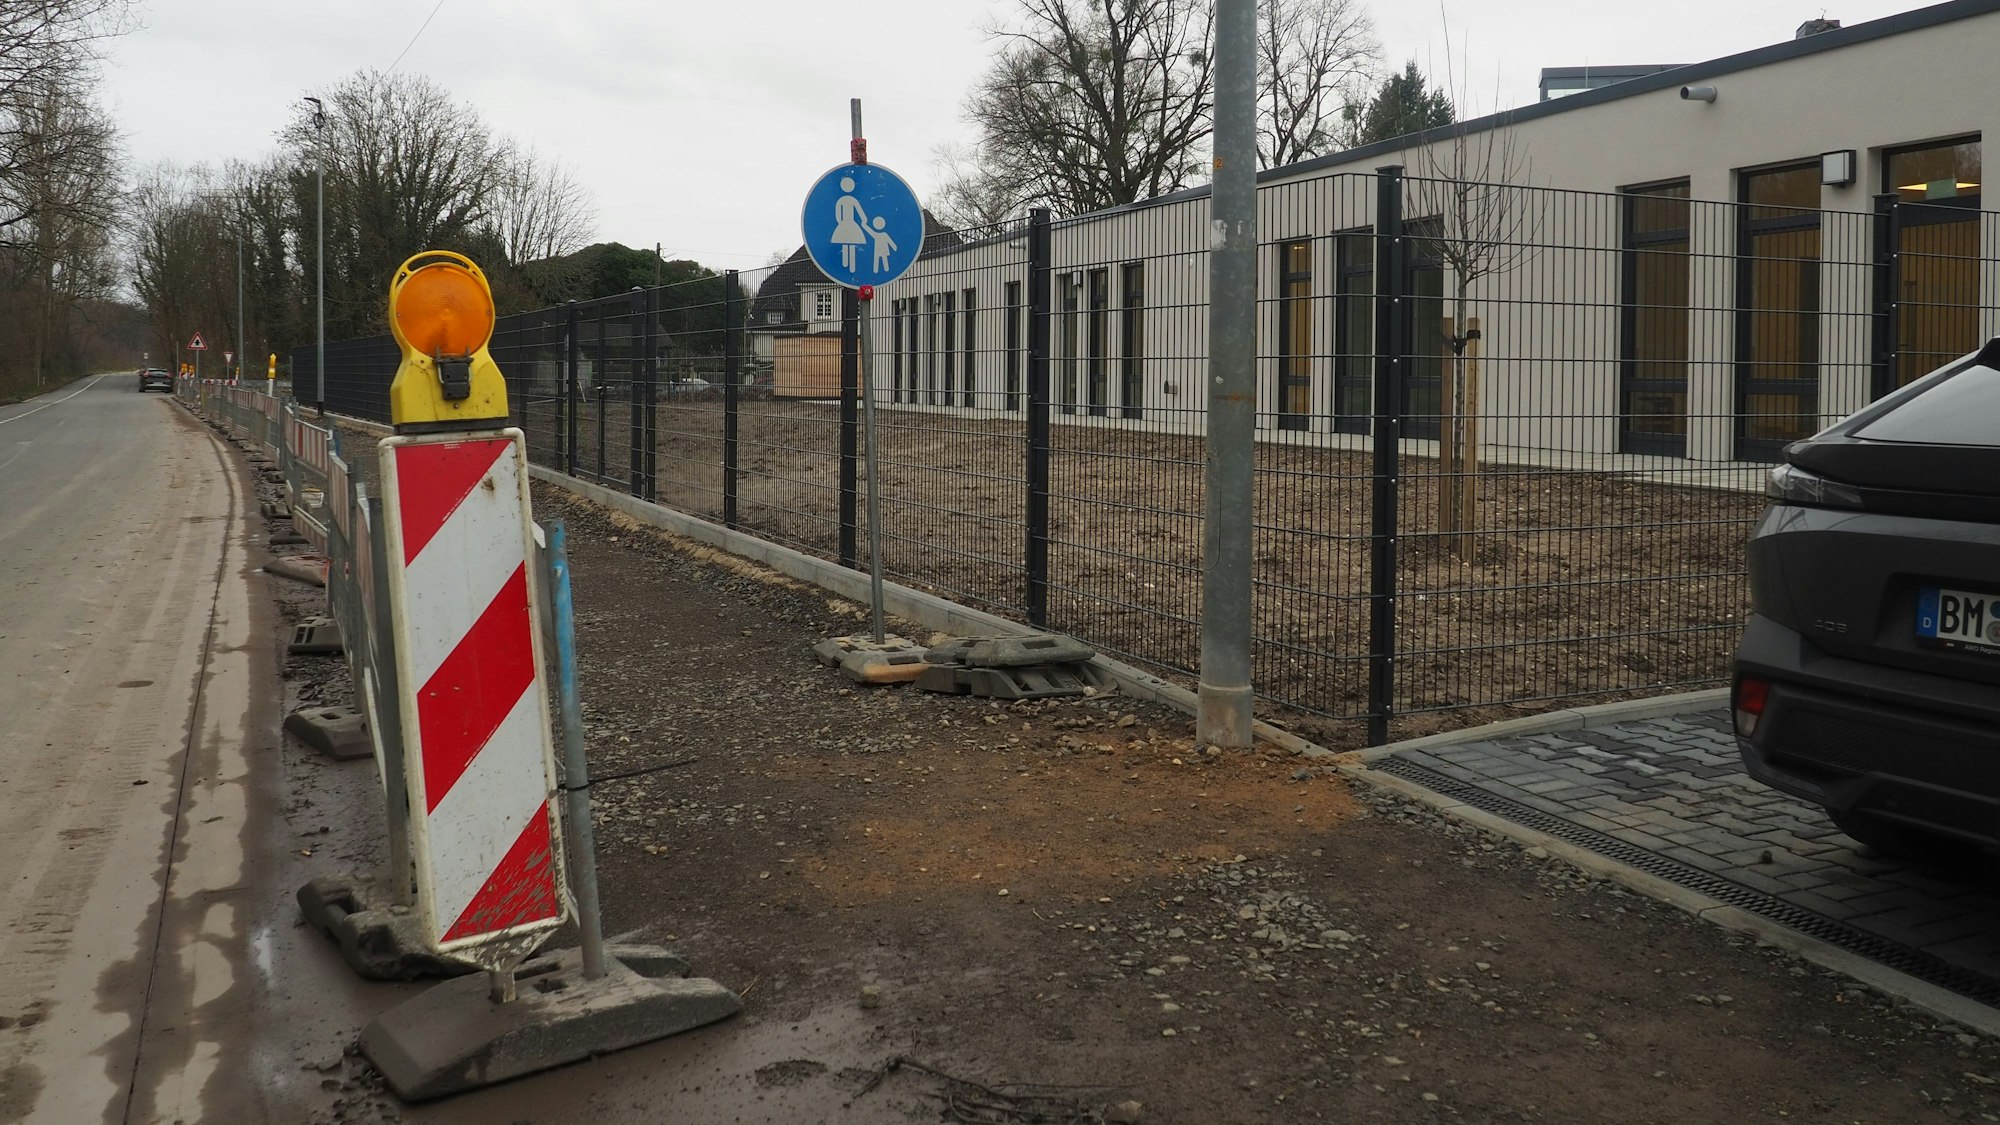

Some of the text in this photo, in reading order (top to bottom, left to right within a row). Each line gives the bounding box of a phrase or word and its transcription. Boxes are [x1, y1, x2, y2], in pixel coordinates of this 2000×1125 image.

[1216, 158, 1222, 168] 2
[1922, 595, 1984, 638] D BM
